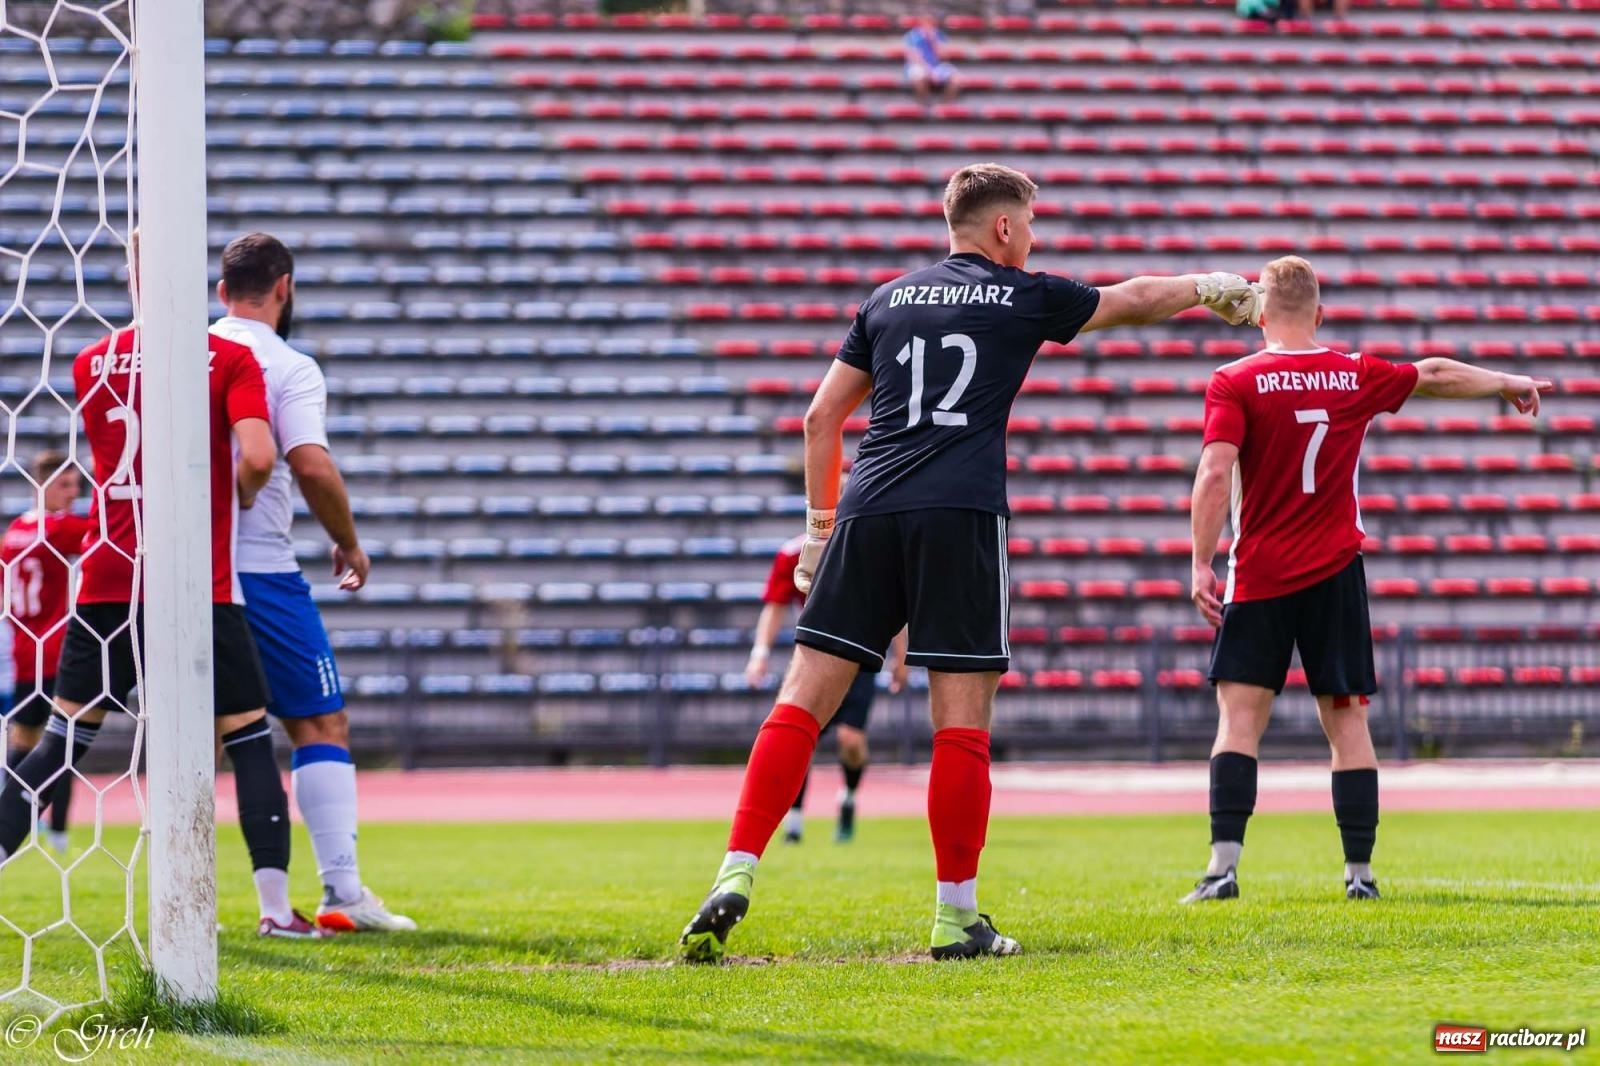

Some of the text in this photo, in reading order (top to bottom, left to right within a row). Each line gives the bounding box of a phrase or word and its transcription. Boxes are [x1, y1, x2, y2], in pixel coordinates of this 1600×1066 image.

[889, 284, 1015, 309] DRZEWIARZ
[896, 333, 977, 427] 12
[1255, 370, 1360, 394] DRZEWIARZ
[1294, 408, 1330, 494] 7
